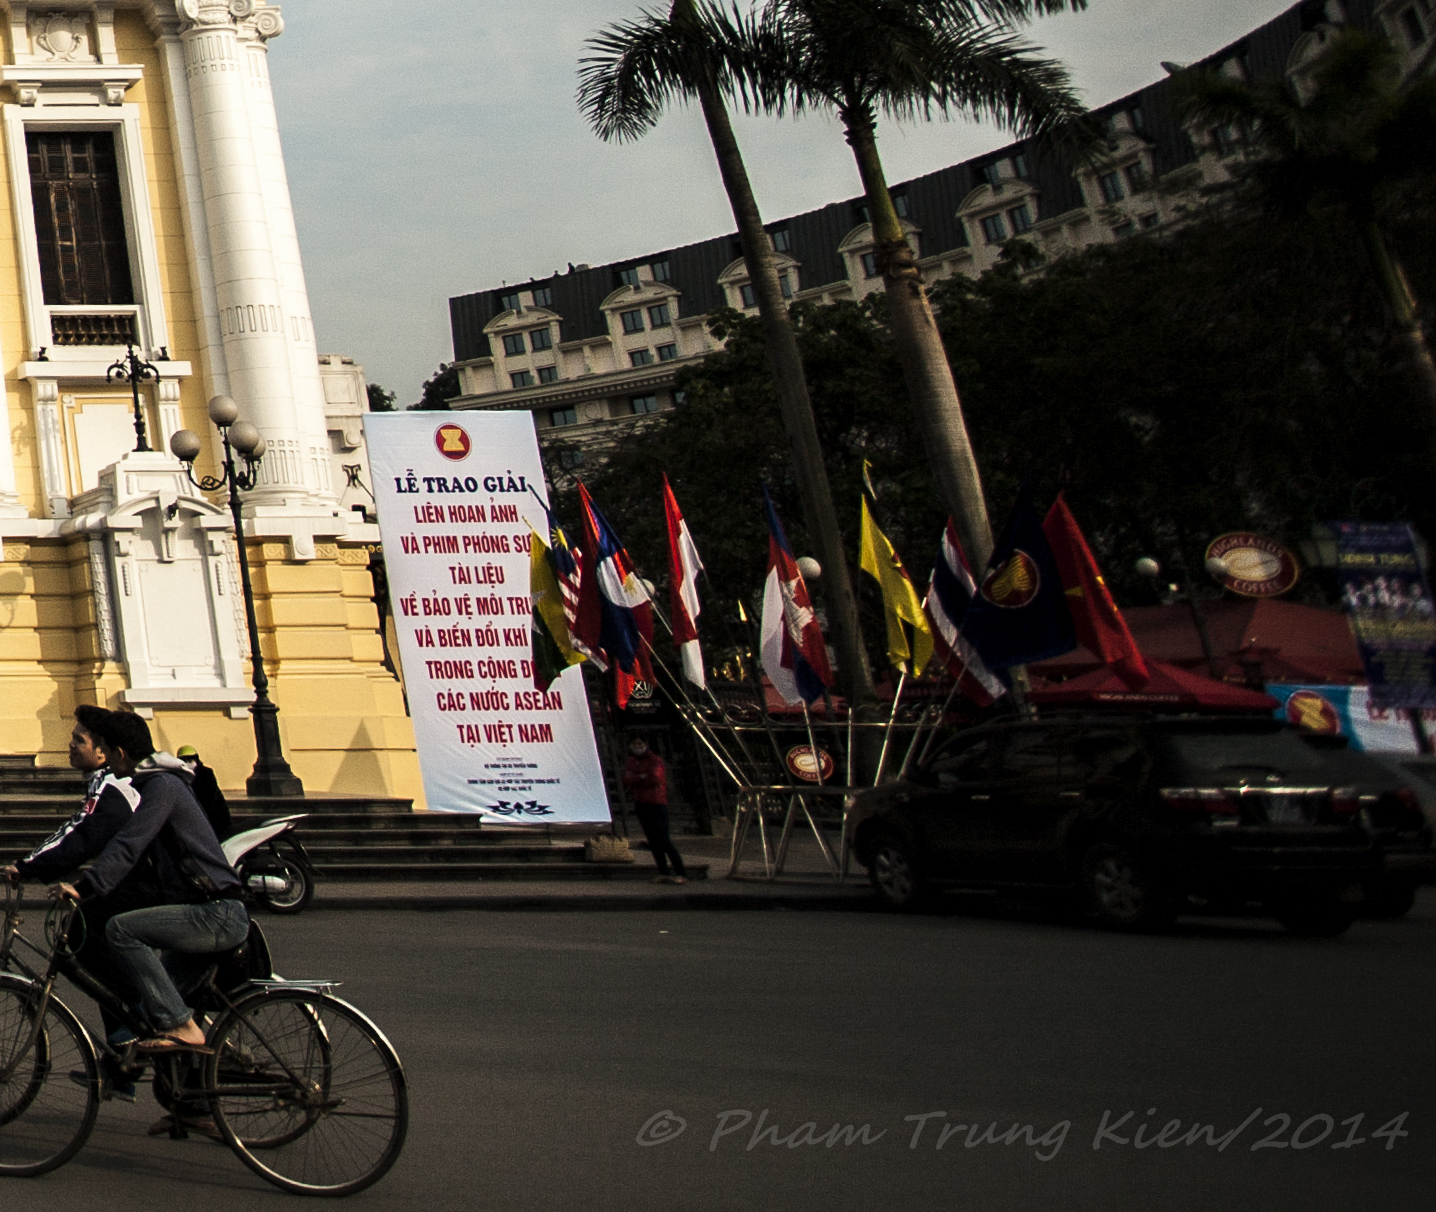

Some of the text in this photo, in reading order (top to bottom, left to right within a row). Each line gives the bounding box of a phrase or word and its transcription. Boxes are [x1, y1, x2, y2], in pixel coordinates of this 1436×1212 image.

[394, 468, 528, 493] LỄ TRAO GIẢI
[413, 496, 519, 523] LIÊN HOAN ẢNH
[400, 531, 421, 554] VÀ
[422, 535, 460, 554] PHIM
[462, 531, 511, 554] PHÓNG
[1210, 536, 1286, 559] HIGHLANDS
[449, 562, 505, 588] TÀI LIỆU
[400, 590, 420, 616] VỀ
[421, 589, 452, 616] BẢO
[454, 592, 473, 619] VỆ
[475, 592, 505, 616] MÔI
[414, 621, 529, 647] VÀ BIẾN ĐỔI KHÍ
[425, 659, 475, 679] TRONG
[477, 656, 519, 683] CỘNG
[436, 686, 564, 711] CÁC NƯỚC ASEAN
[456, 719, 555, 748] TẠI VIỆT NAM
